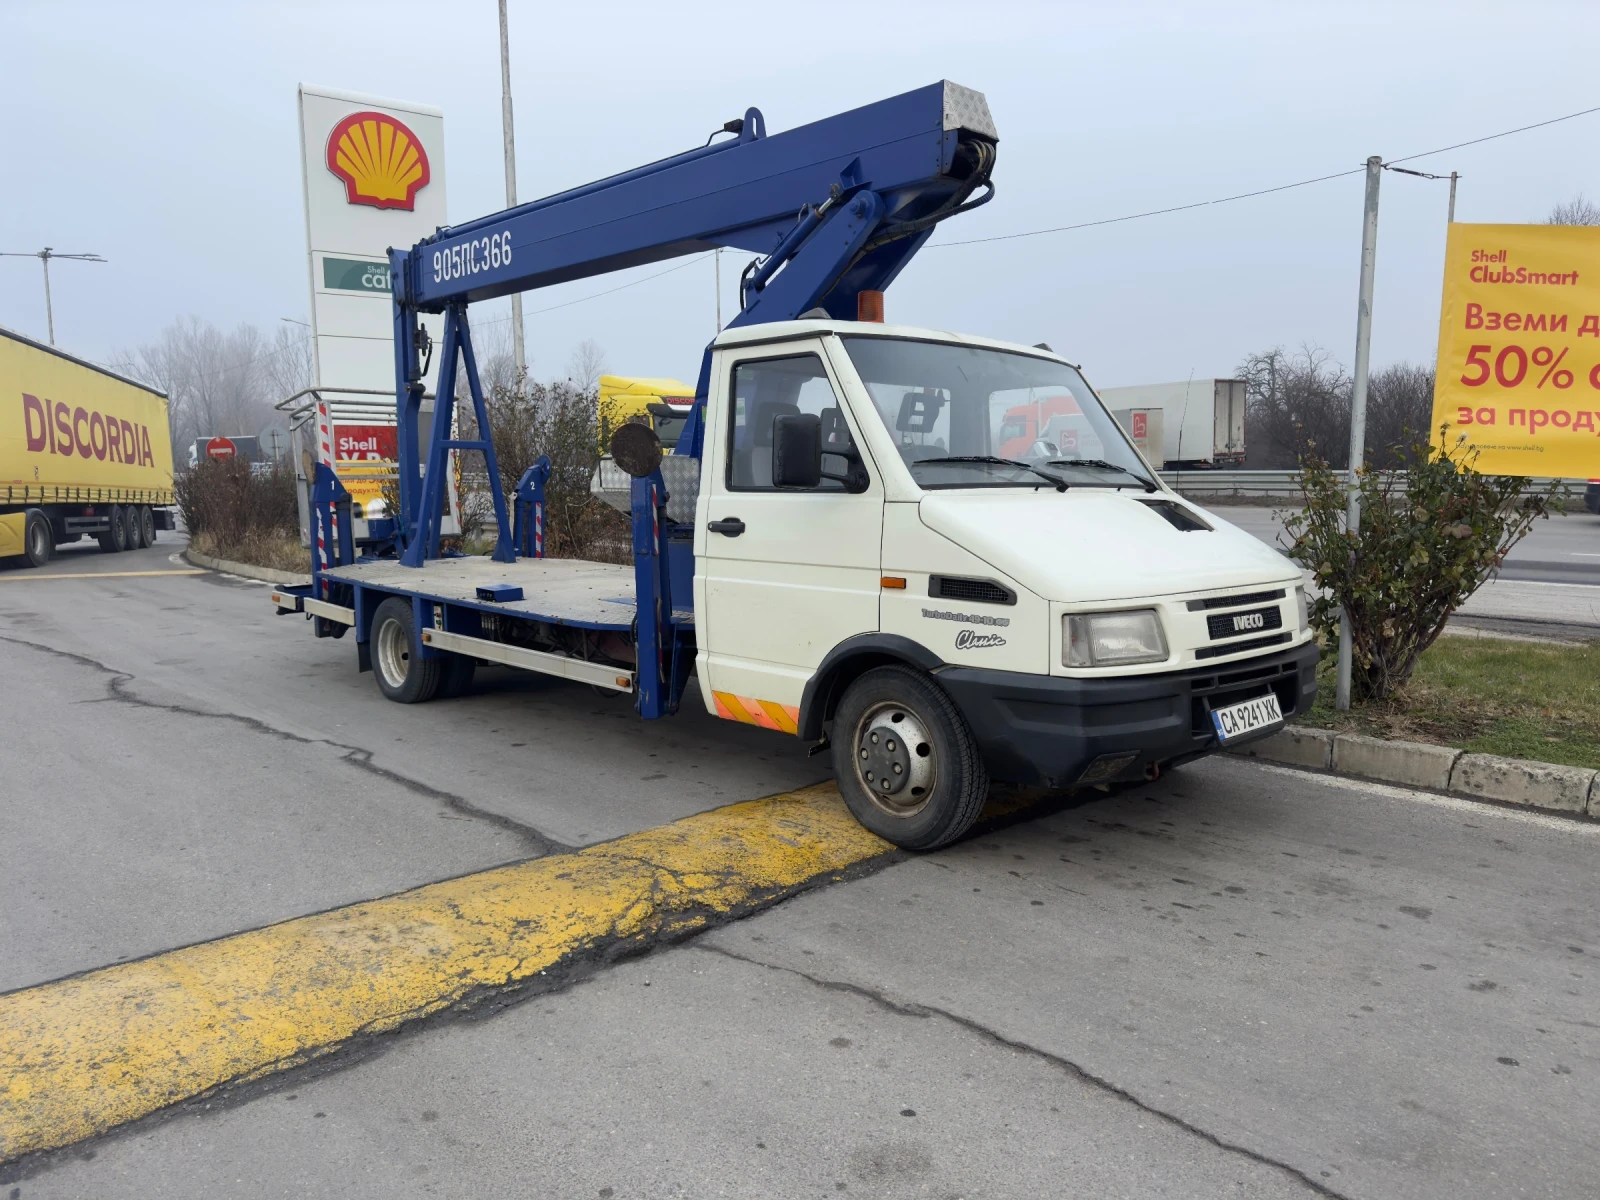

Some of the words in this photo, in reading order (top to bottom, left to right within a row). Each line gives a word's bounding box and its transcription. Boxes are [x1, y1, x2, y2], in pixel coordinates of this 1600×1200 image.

[433, 230, 512, 283] 905ПС366
[1471, 249, 1507, 263] Shell
[367, 265, 386, 275] Shell
[1469, 265, 1579, 286] ClubSmart
[1464, 302, 1568, 333] Вземи
[1460, 344, 1574, 390] 50%
[1456, 406, 1496, 425] за
[22, 392, 155, 468] DISCORDIA
[340, 437, 377, 450] Shell
[330, 480, 335, 490] 1
[530, 481, 536, 490] 2
[921, 608, 968, 623] TurboDaily
[1233, 613, 1263, 631] IVECO
[955, 630, 1006, 650] Classic
[1221, 710, 1240, 734] CA
[1237, 702, 1263, 729] 9241
[1261, 697, 1280, 720] XK
